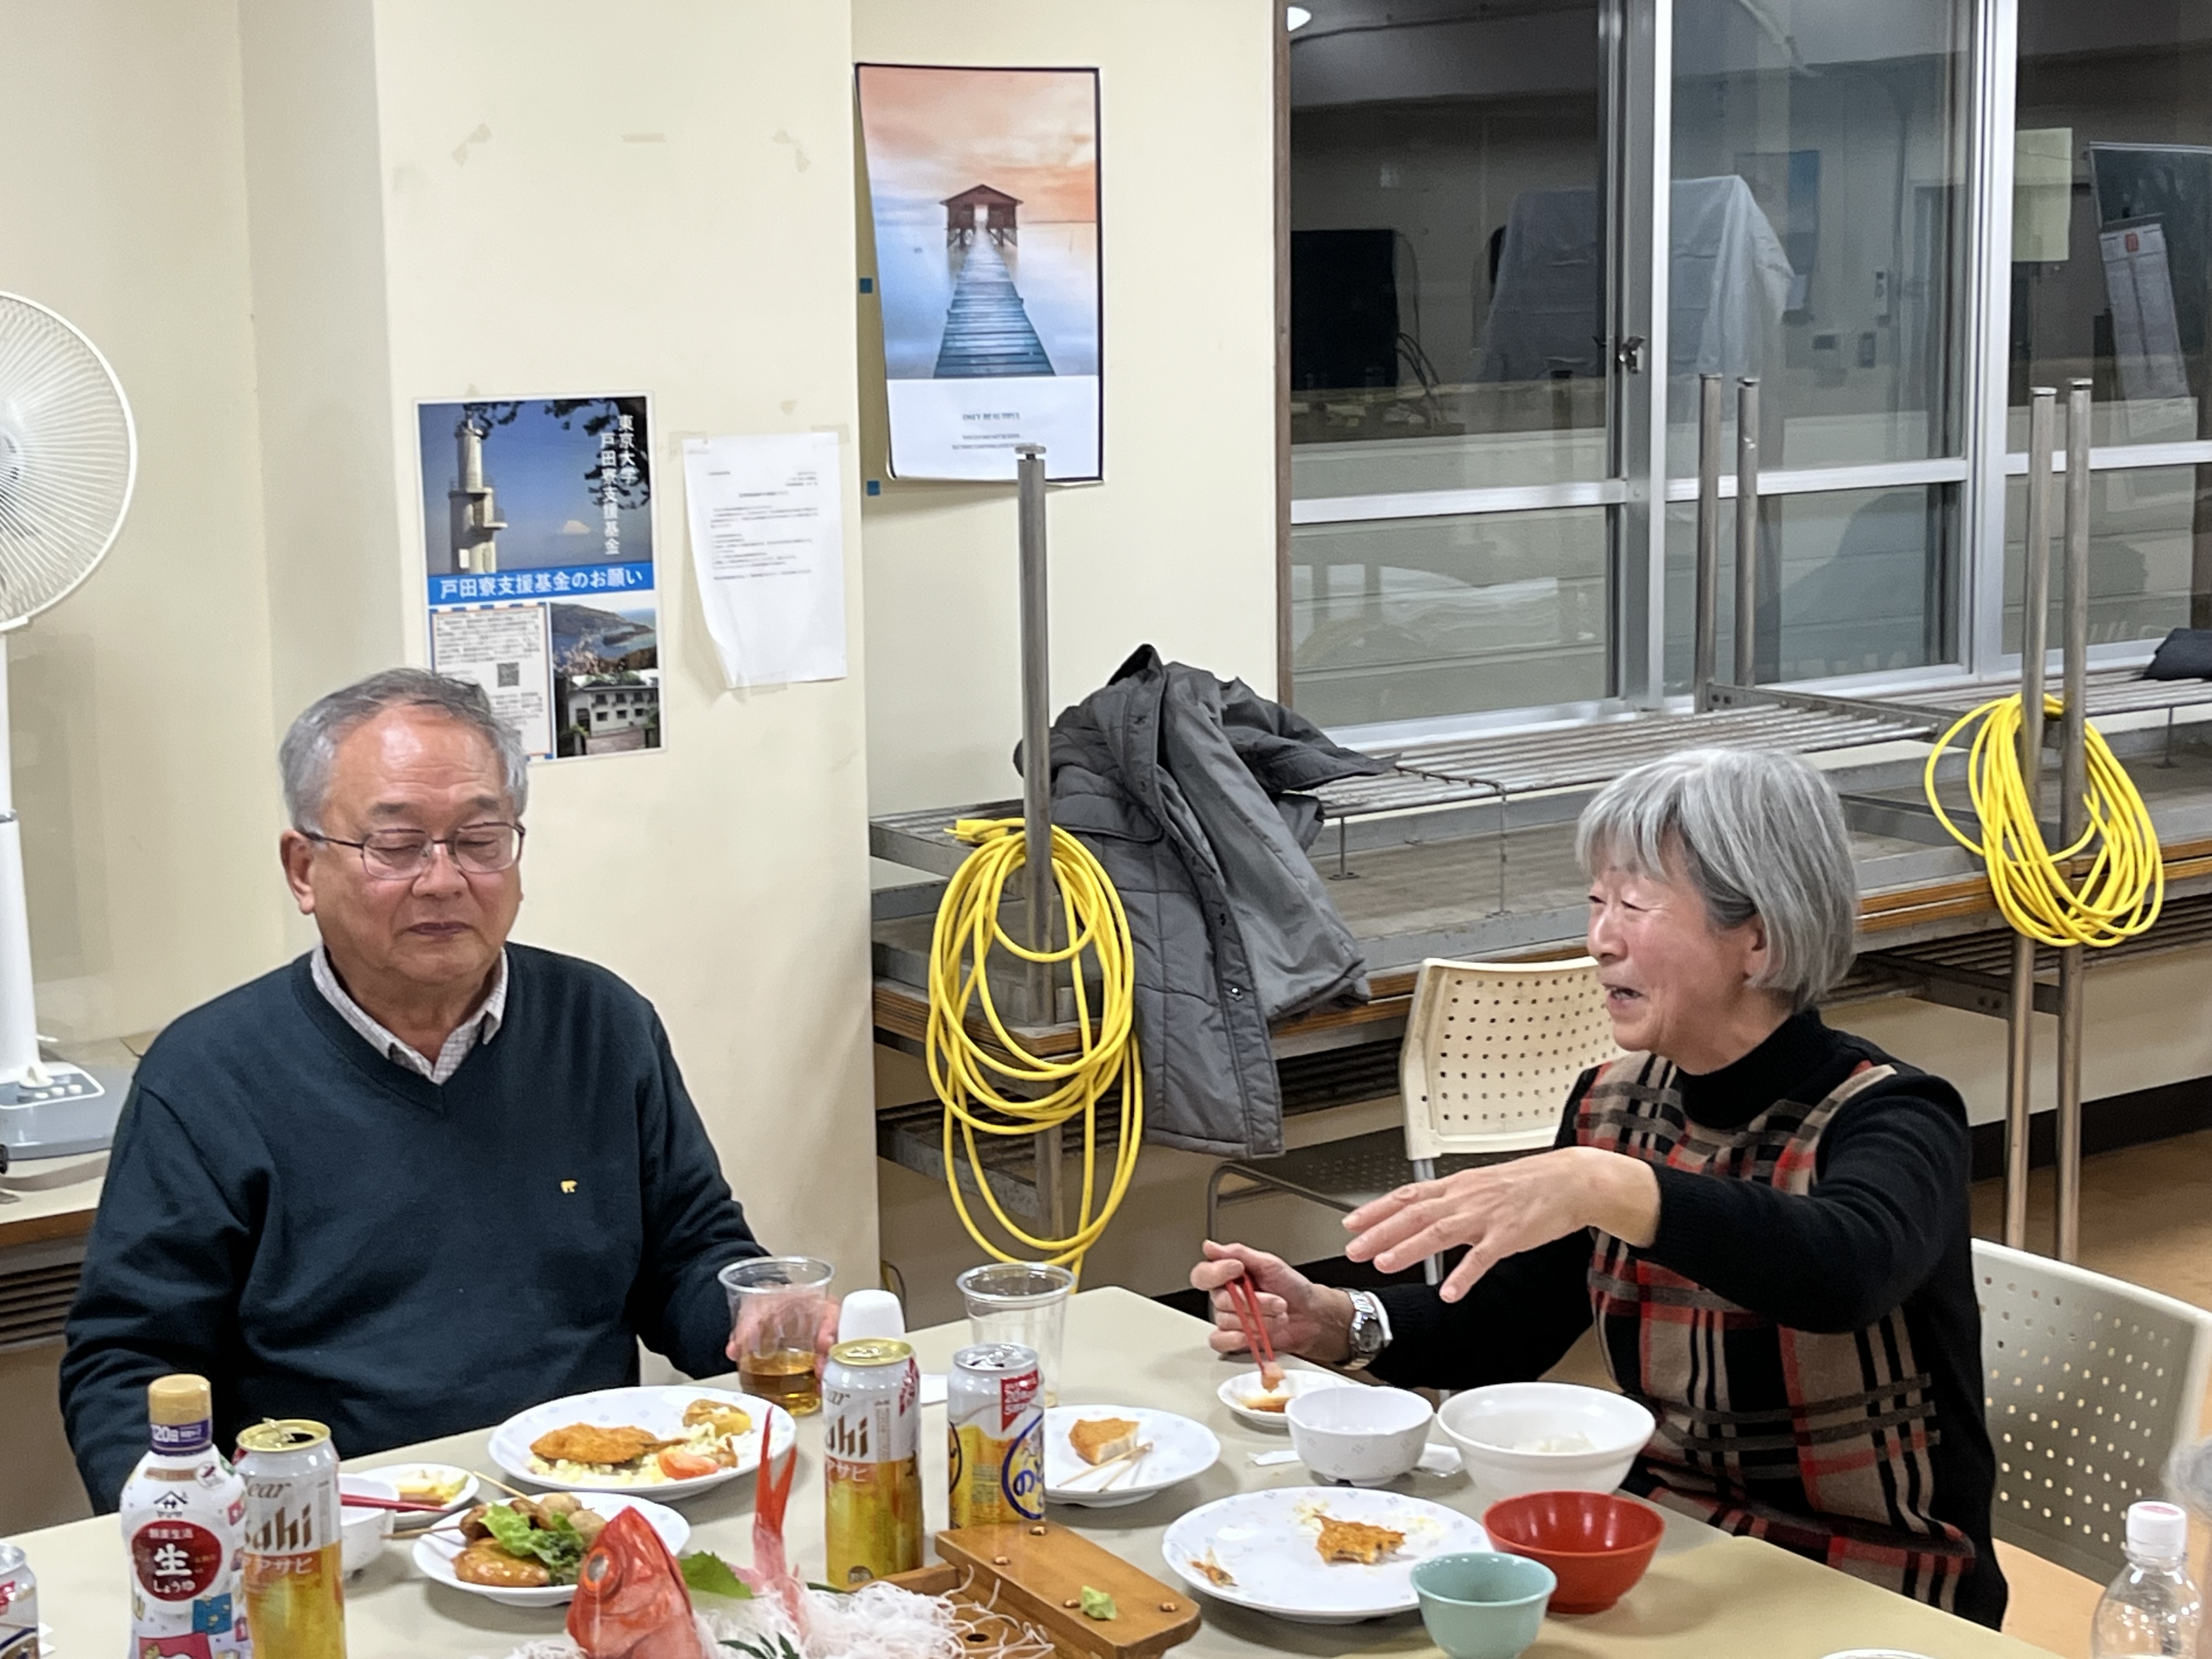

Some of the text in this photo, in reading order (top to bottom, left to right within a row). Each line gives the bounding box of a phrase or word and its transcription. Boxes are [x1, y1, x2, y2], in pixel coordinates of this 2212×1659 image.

[600, 432, 620, 555] 戸田寮支援基金
[440, 567, 643, 600] 戸田寮支援基金のお願い
[154, 1543, 192, 1576] 生
